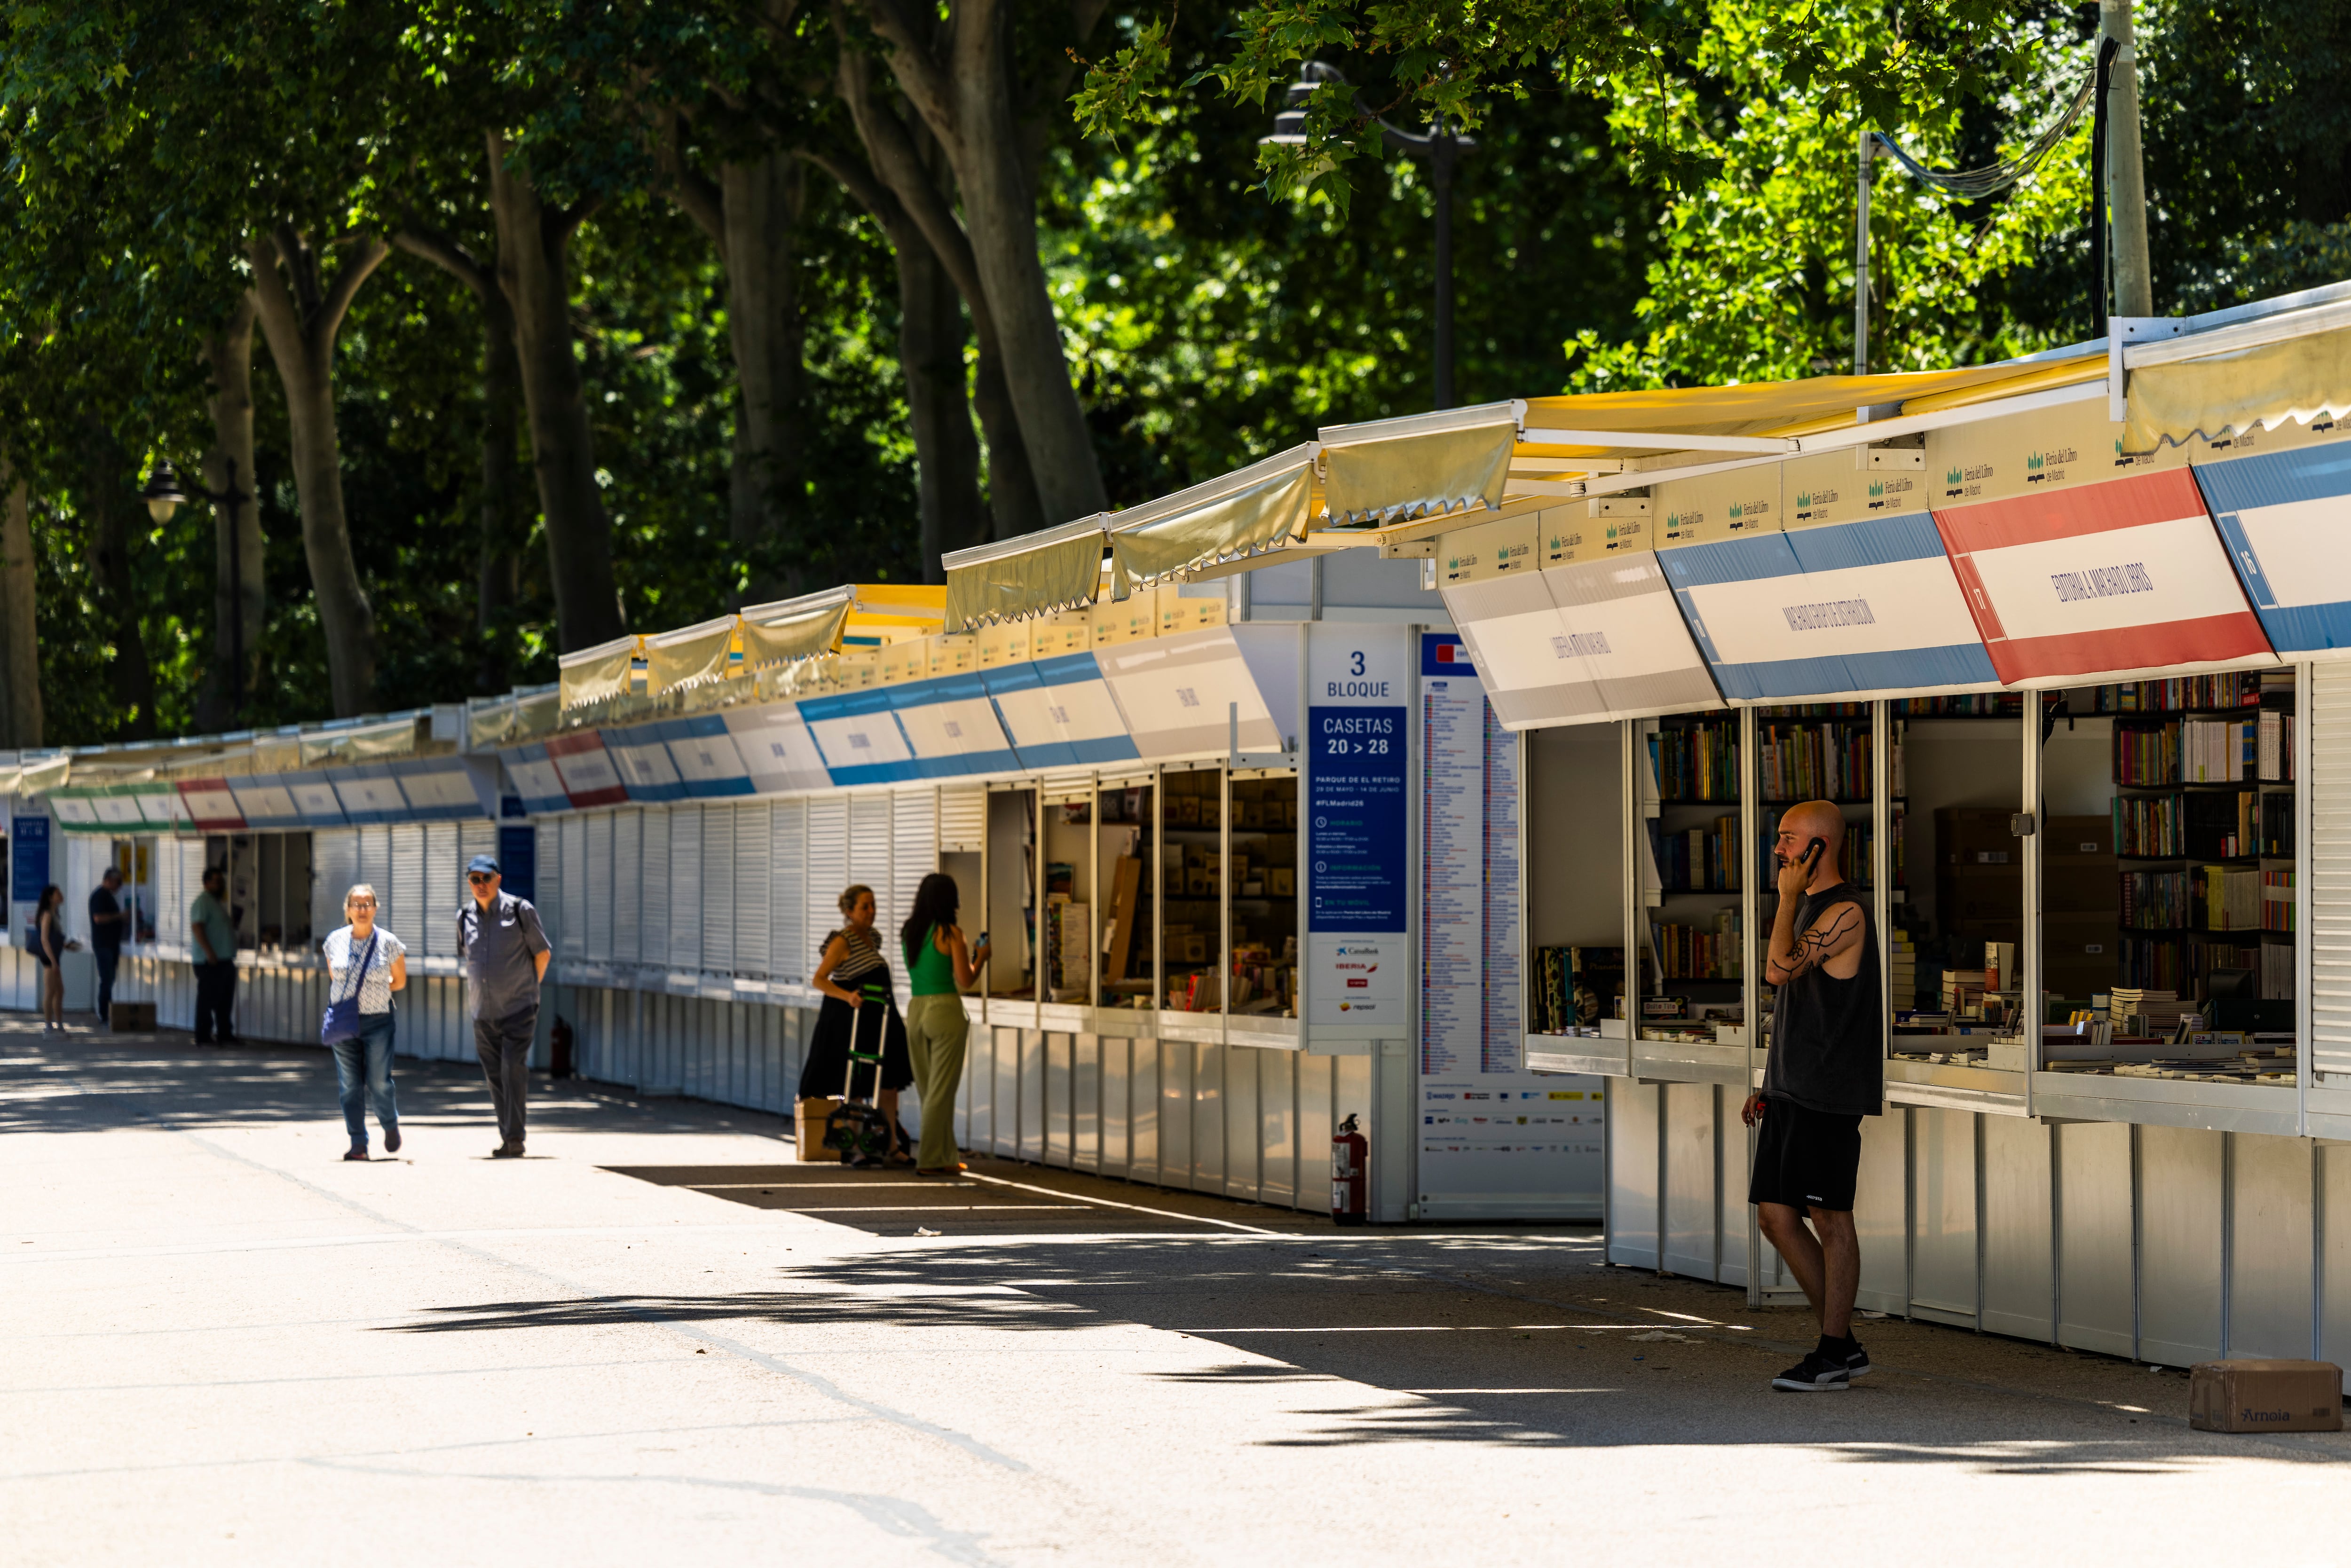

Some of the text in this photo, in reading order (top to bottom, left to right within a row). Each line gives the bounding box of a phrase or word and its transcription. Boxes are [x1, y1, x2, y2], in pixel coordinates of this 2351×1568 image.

[2046, 451, 2058, 466] Feria
[2065, 447, 2077, 463] Libro
[1965, 466, 1975, 481] Feria
[1981, 464, 1993, 479] Libro
[2046, 467, 2065, 482] de Madrid
[1885, 480, 1895, 494] Feria
[1902, 477, 1912, 492] Libro
[1964, 483, 1980, 496] de Madrid
[1813, 491, 1822, 505] Feria
[1829, 489, 1838, 504] Libro
[1885, 496, 1901, 509] de Madrid
[1744, 502, 1753, 516] Feria
[1759, 500, 1768, 513] Libro
[1813, 507, 1828, 520] de Madrid
[1680, 512, 1689, 526] Feria
[1694, 511, 1704, 524] Libro
[1744, 517, 1759, 530] de Madrid
[1632, 521, 1641, 534] Libro
[1680, 528, 1694, 539] de Madrid
[1574, 533, 1582, 545] Libro
[2241, 551, 2256, 575] 16
[2051, 562, 2153, 602] EDITORIAL A. MACHADO LIBROS
[1973, 588, 1986, 610] 17
[1782, 593, 1876, 631] MACHADO GRUPO DE DISTRIBUCIÓN
[1694, 619, 1705, 638] 18
[1351, 651, 1365, 676] 3
[1327, 682, 1389, 698] BLOQUE
[1324, 718, 1392, 734] CASETAS
[1328, 739, 1348, 754] 20
[1368, 739, 1389, 754] 28
[2241, 1409, 2290, 1422] Arnoia
